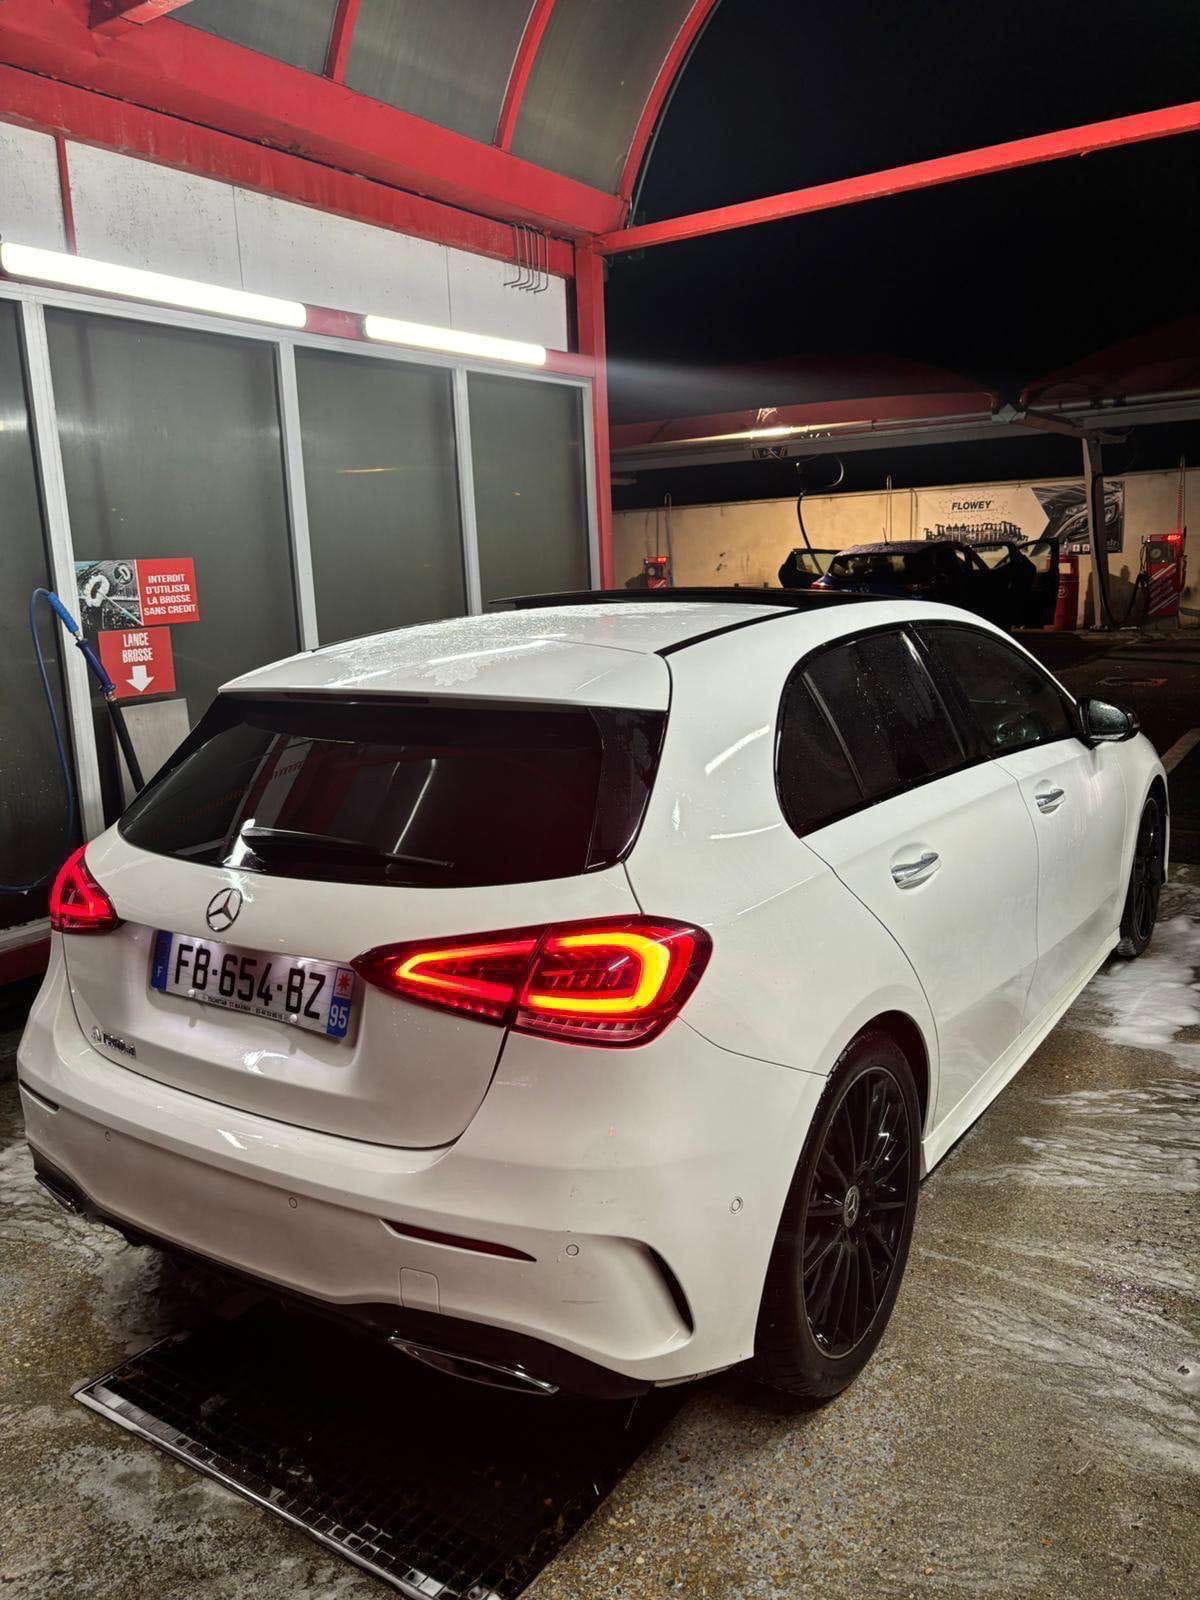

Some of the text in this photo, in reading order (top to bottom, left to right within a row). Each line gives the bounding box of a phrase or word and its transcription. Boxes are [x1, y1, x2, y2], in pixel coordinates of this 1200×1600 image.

[951, 500, 992, 510] FLOWEY
[147, 574, 185, 583] INTERDIT
[145, 584, 190, 595] D'UTILISER
[147, 594, 191, 605] LA BROSSE
[143, 604, 196, 616] SANS CREDIT
[122, 632, 149, 647] LANCE
[122, 647, 154, 663] BROSSE
[157, 966, 163, 976] F
[329, 1004, 349, 1029] 95
